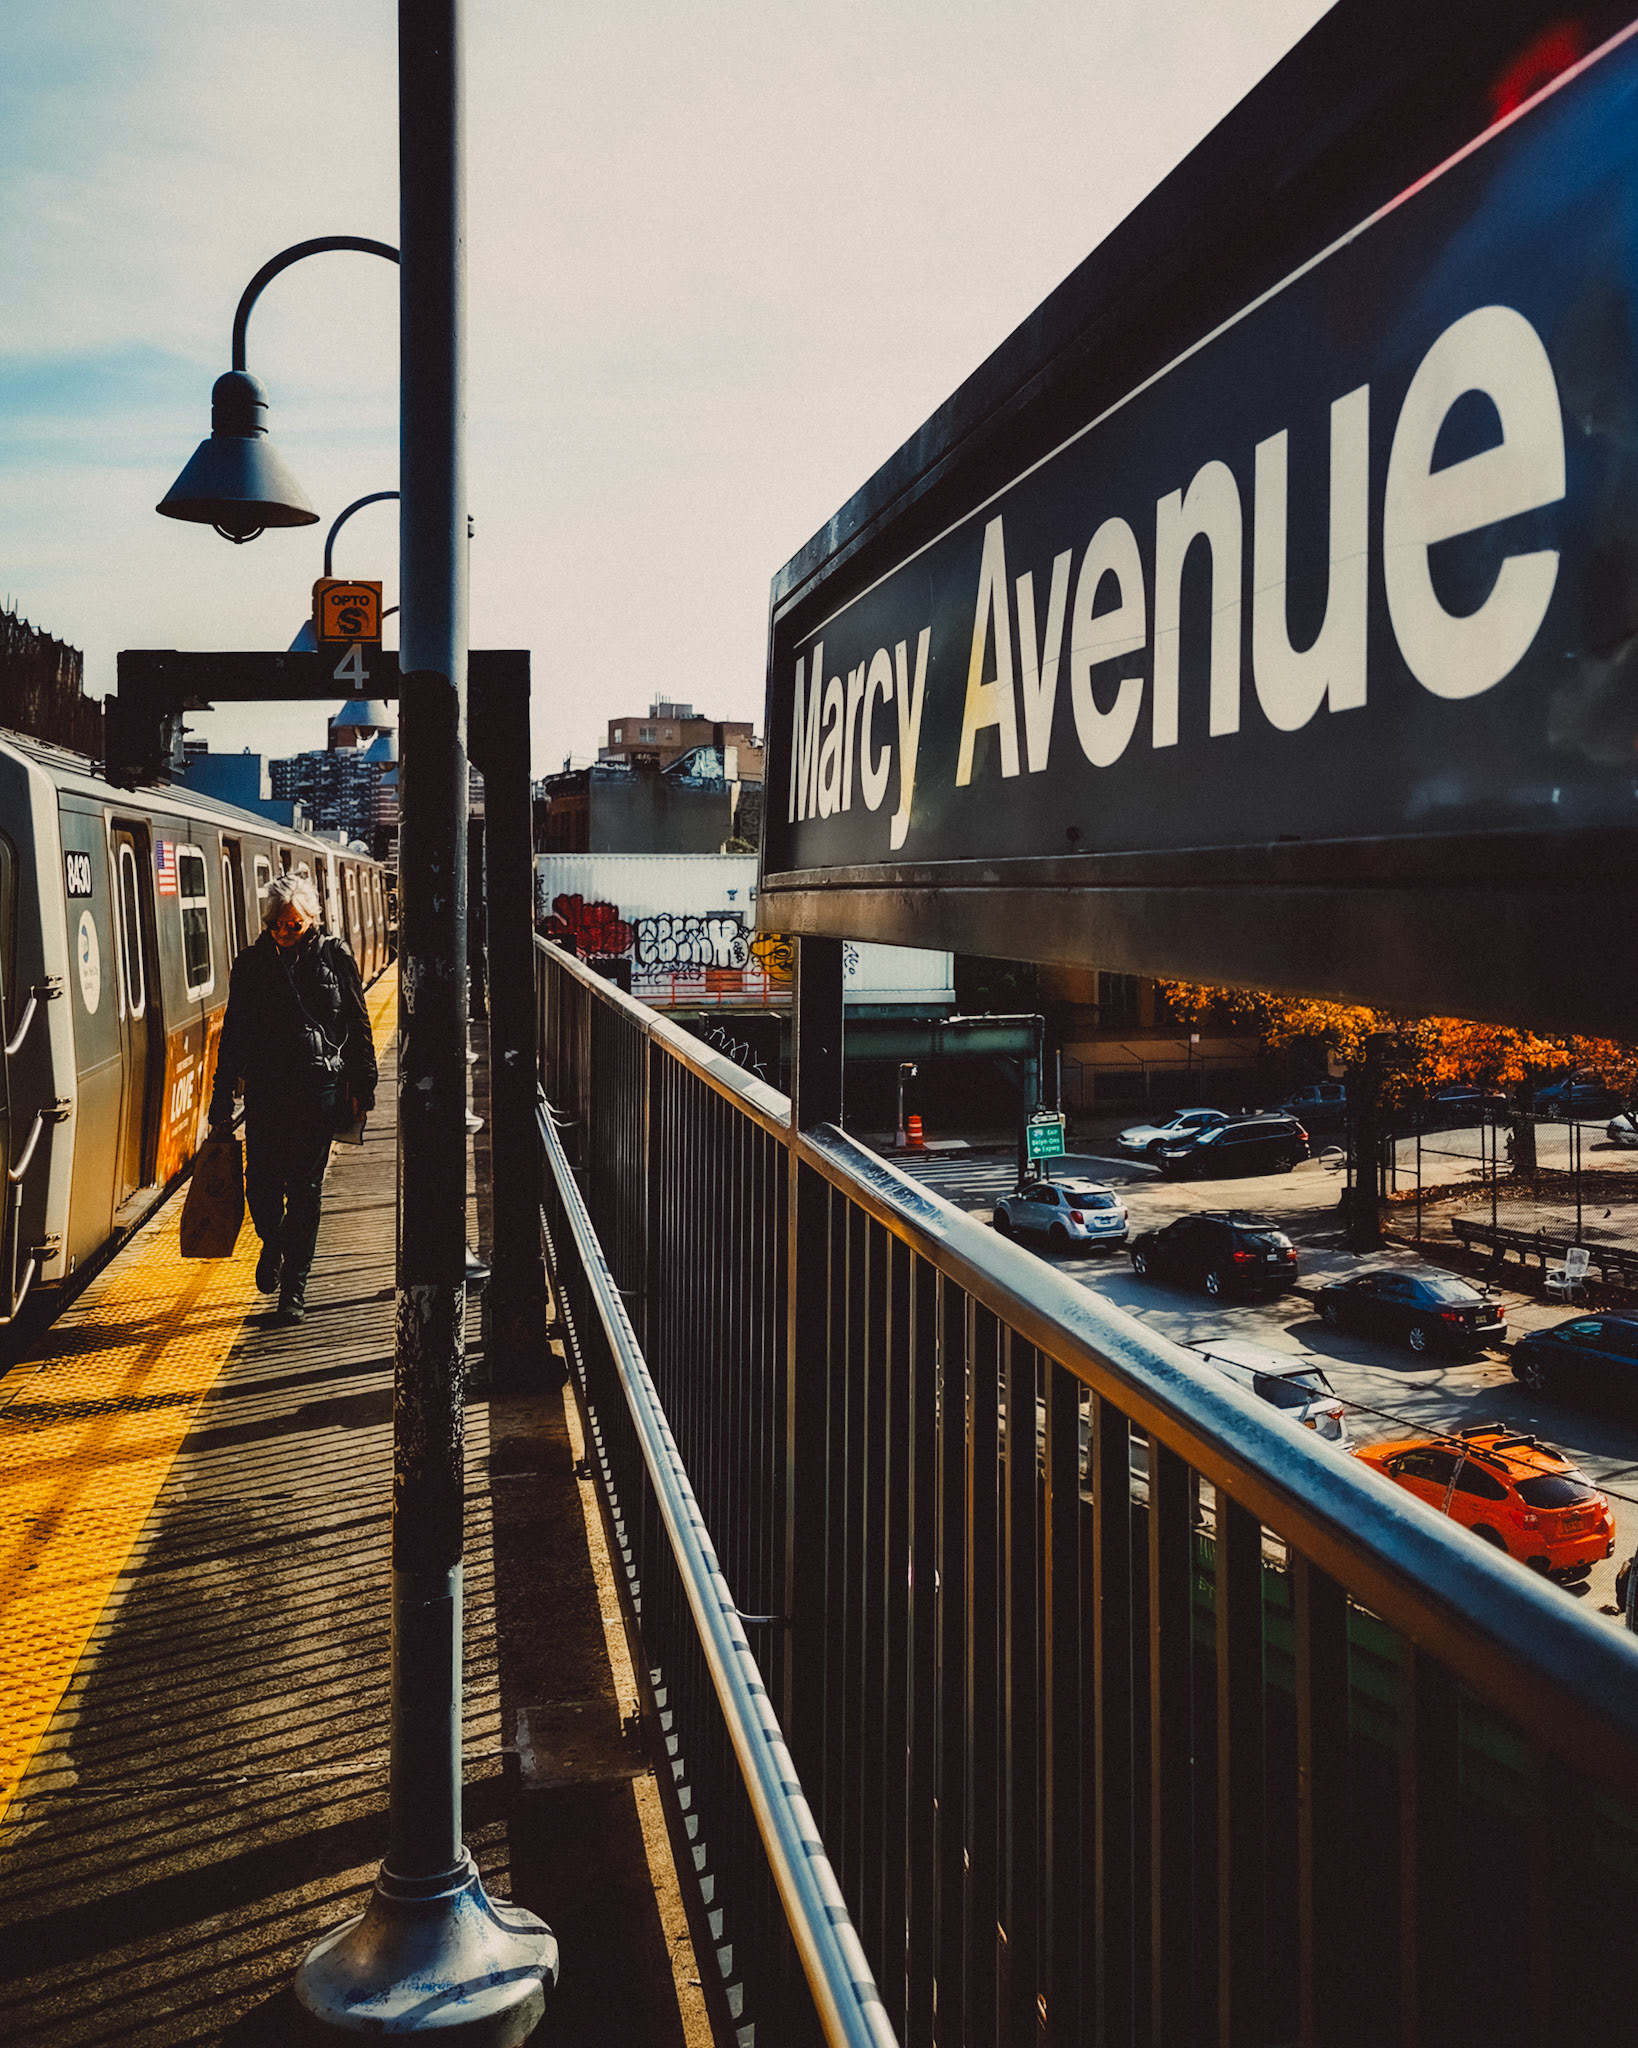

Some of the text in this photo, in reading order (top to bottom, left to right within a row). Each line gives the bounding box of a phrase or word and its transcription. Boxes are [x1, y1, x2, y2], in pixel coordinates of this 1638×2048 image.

[787, 304, 1567, 851] Marcy Avenue
[331, 595, 370, 606] OPTO
[338, 607, 363, 634] S
[333, 643, 370, 690] 4
[66, 854, 91, 894] 8430
[170, 1070, 195, 1124] LOVE
